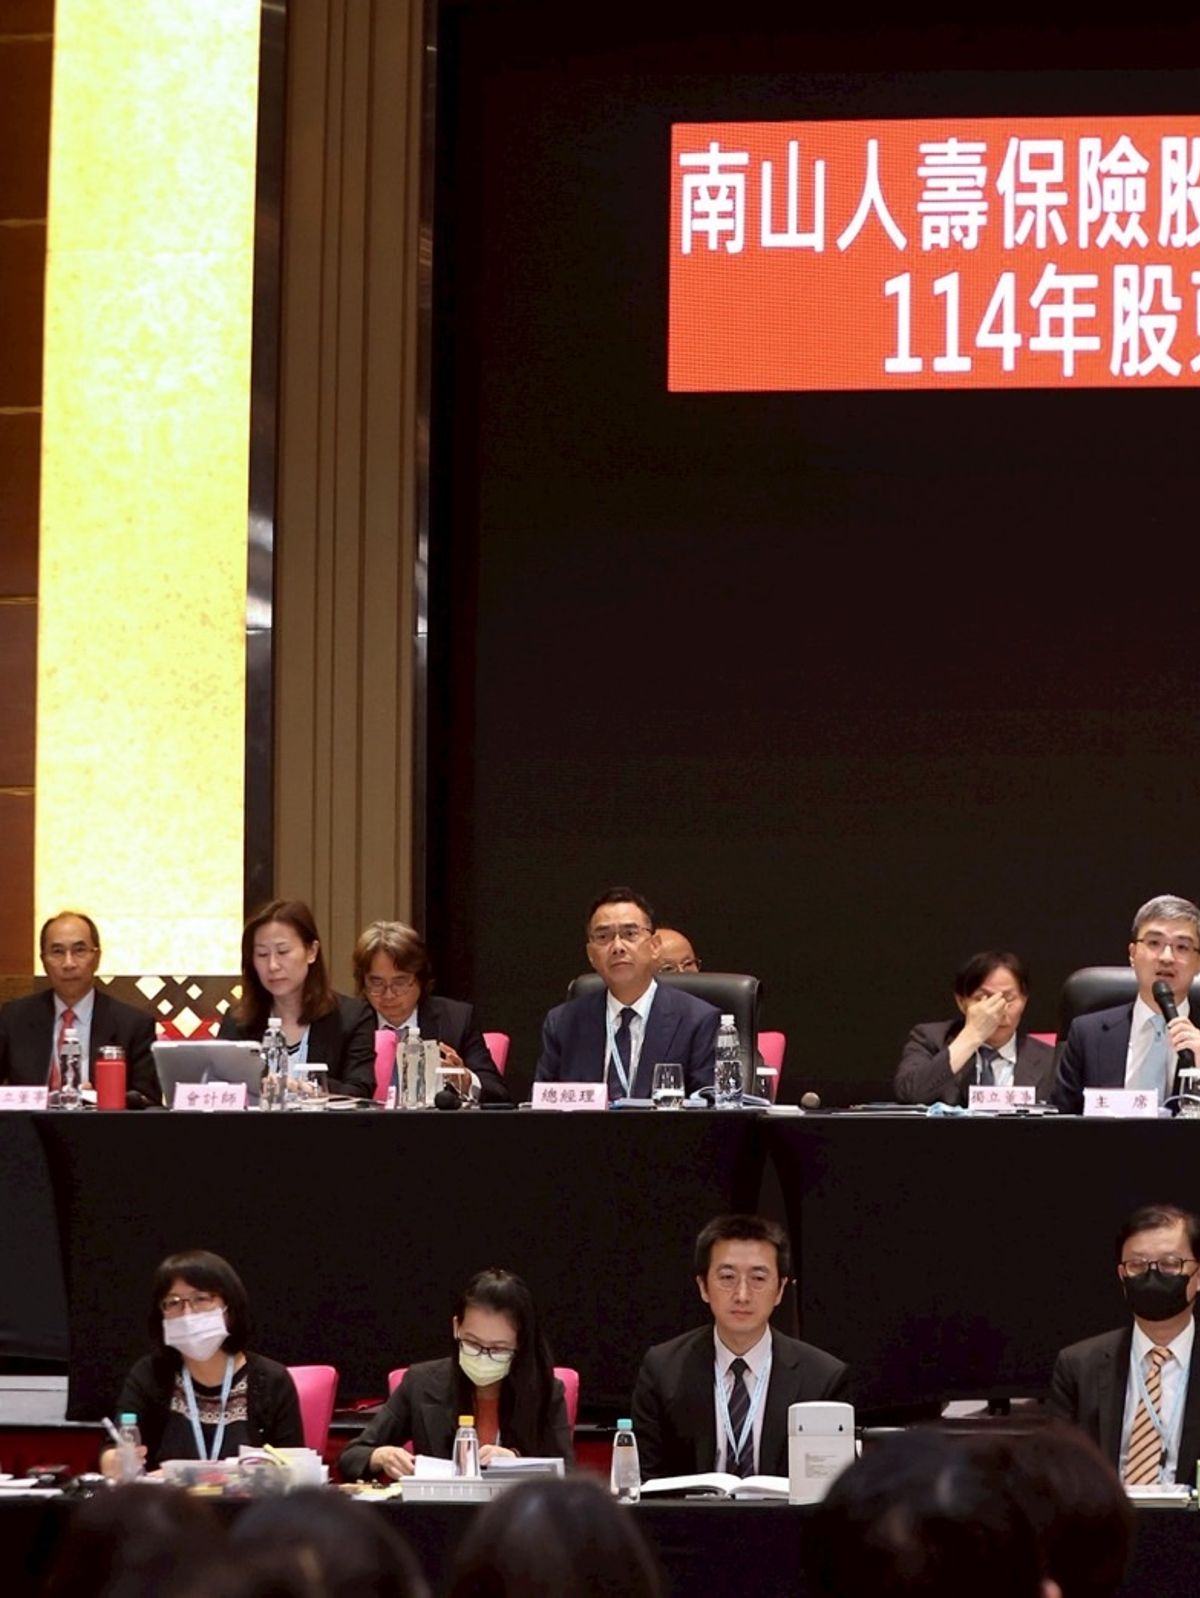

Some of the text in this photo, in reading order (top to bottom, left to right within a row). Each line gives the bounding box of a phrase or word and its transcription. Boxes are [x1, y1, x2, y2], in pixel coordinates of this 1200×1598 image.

[186, 1086, 237, 1105] 會計師
[540, 1087, 596, 1104] 總經理
